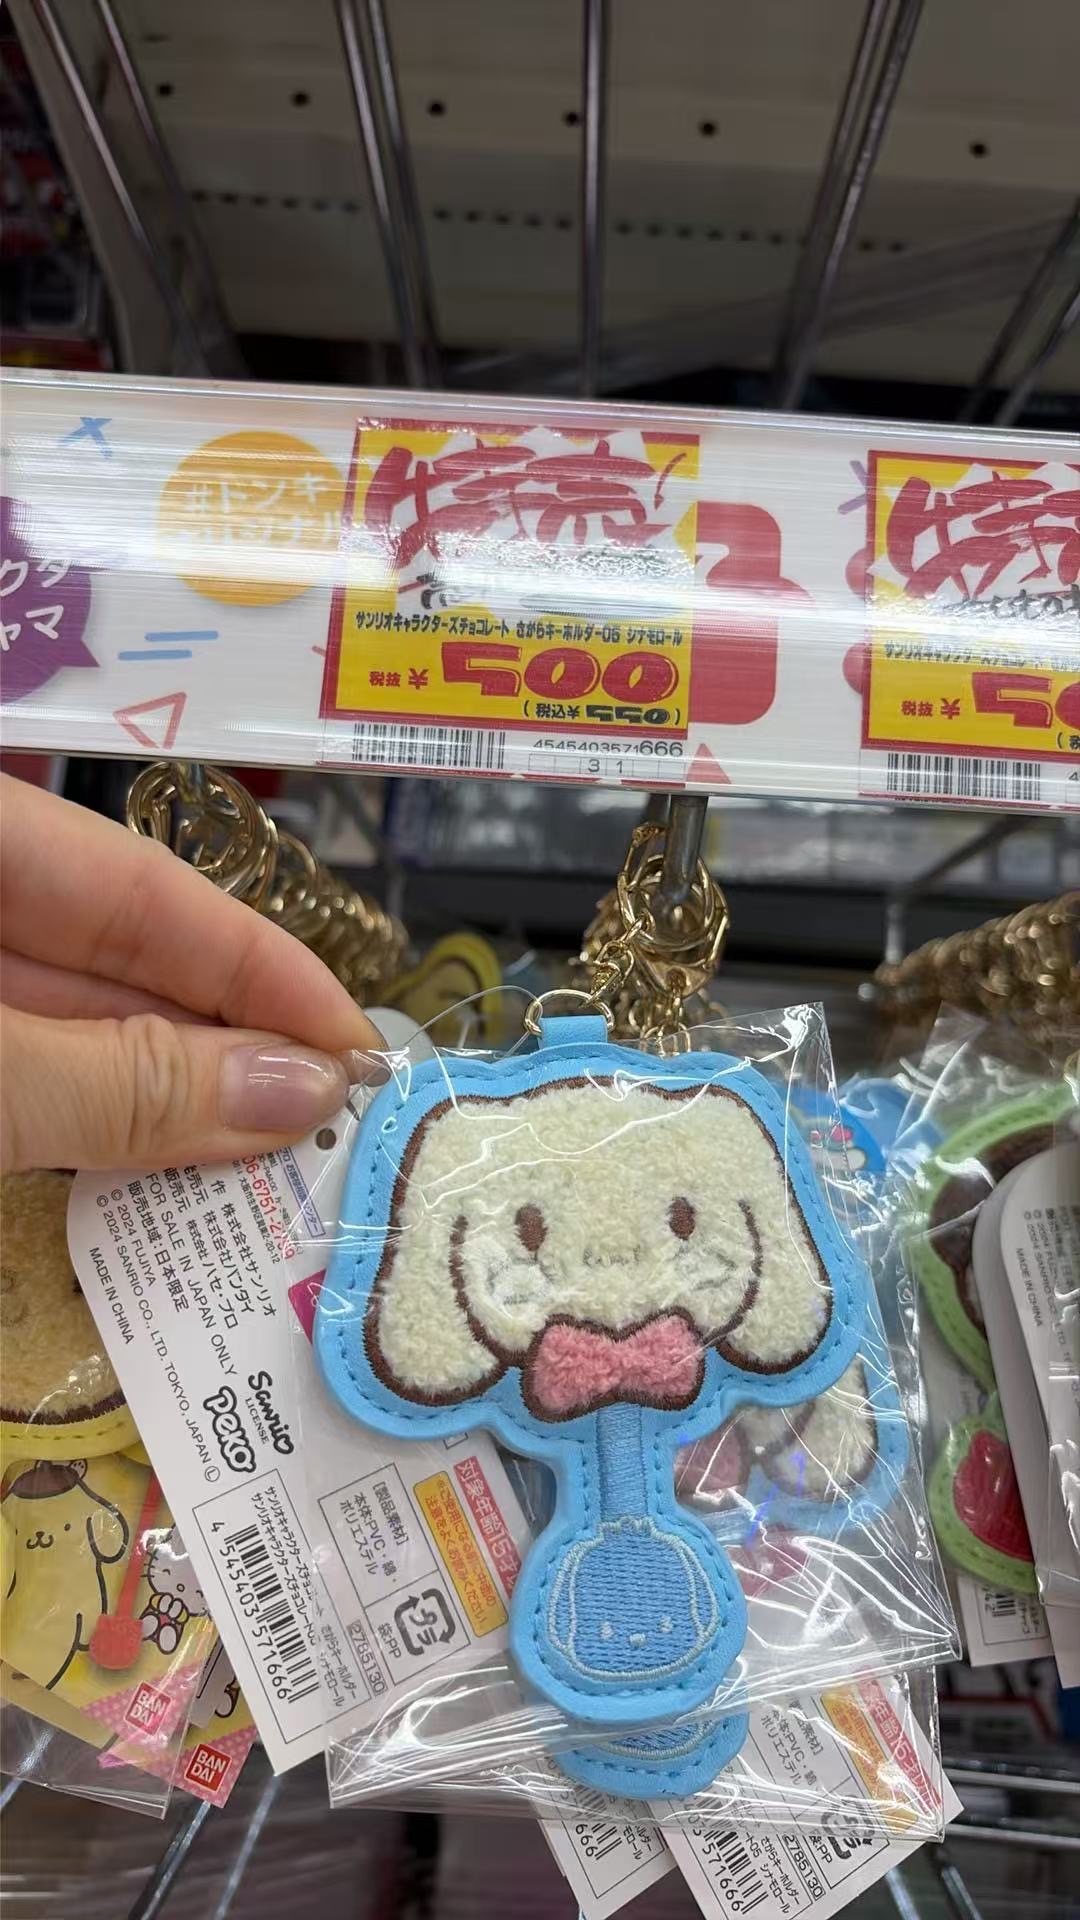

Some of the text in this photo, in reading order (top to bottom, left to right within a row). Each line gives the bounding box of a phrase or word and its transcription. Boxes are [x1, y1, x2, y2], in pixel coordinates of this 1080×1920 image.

[356, 611, 509, 637] サンリオキャラクターズチョコレート
[627, 627, 682, 646] シナモロール
[369, 671, 401, 688] 税抜
[533, 739, 683, 757] 4545403571666
[587, 758, 600, 773] 3
[161, 1165, 192, 1214] 販売元
[109, 1188, 155, 1286] © 2024 FUJIYA
[126, 1180, 188, 1310] 販売地域:日本限定
[144, 1171, 237, 1374] FOR SALE IN JAPAN ONLY
[203, 1210, 253, 1311] 株式会社バンダイ
[221, 1203, 275, 1315] 株式会社サンリオ
[89, 1247, 133, 1344] MADE IN CHINA
[1016, 1247, 1043, 1326] MADE IN CHINA
[95, 1192, 109, 1207] ©
[102, 1210, 122, 1241] 2024
[116, 1245, 143, 1296] SANRIO
[138, 1299, 153, 1328] CO.,
[150, 1330, 167, 1360] LTD.
[164, 1362, 189, 1415] TOKYO,
[185, 1419, 211, 1463] JAPAN
[245, 1397, 269, 1444] LICENSE
[248, 1371, 293, 1454] Sanrio
[339, 1499, 378, 1574] ポリエステル
[211, 1522, 294, 1699] 4 545403 571666
[312, 1650, 348, 1708] シナモロール
[317, 1622, 364, 1701] さがらキーホルダー
[345, 1621, 387, 1693] 2785130
[130, 1703, 151, 1727] DAI
[138, 1691, 166, 1714] BAN
[190, 1764, 217, 1784] DAI
[197, 1750, 226, 1772] BAN
[758, 1713, 805, 1787] ポリエステル
[702, 1842, 746, 1911] 571666
[758, 1835, 803, 1906] さがらキーホルダー
[758, 1862, 792, 1914] シナモロール
[783, 1833, 824, 1898] 2785130
